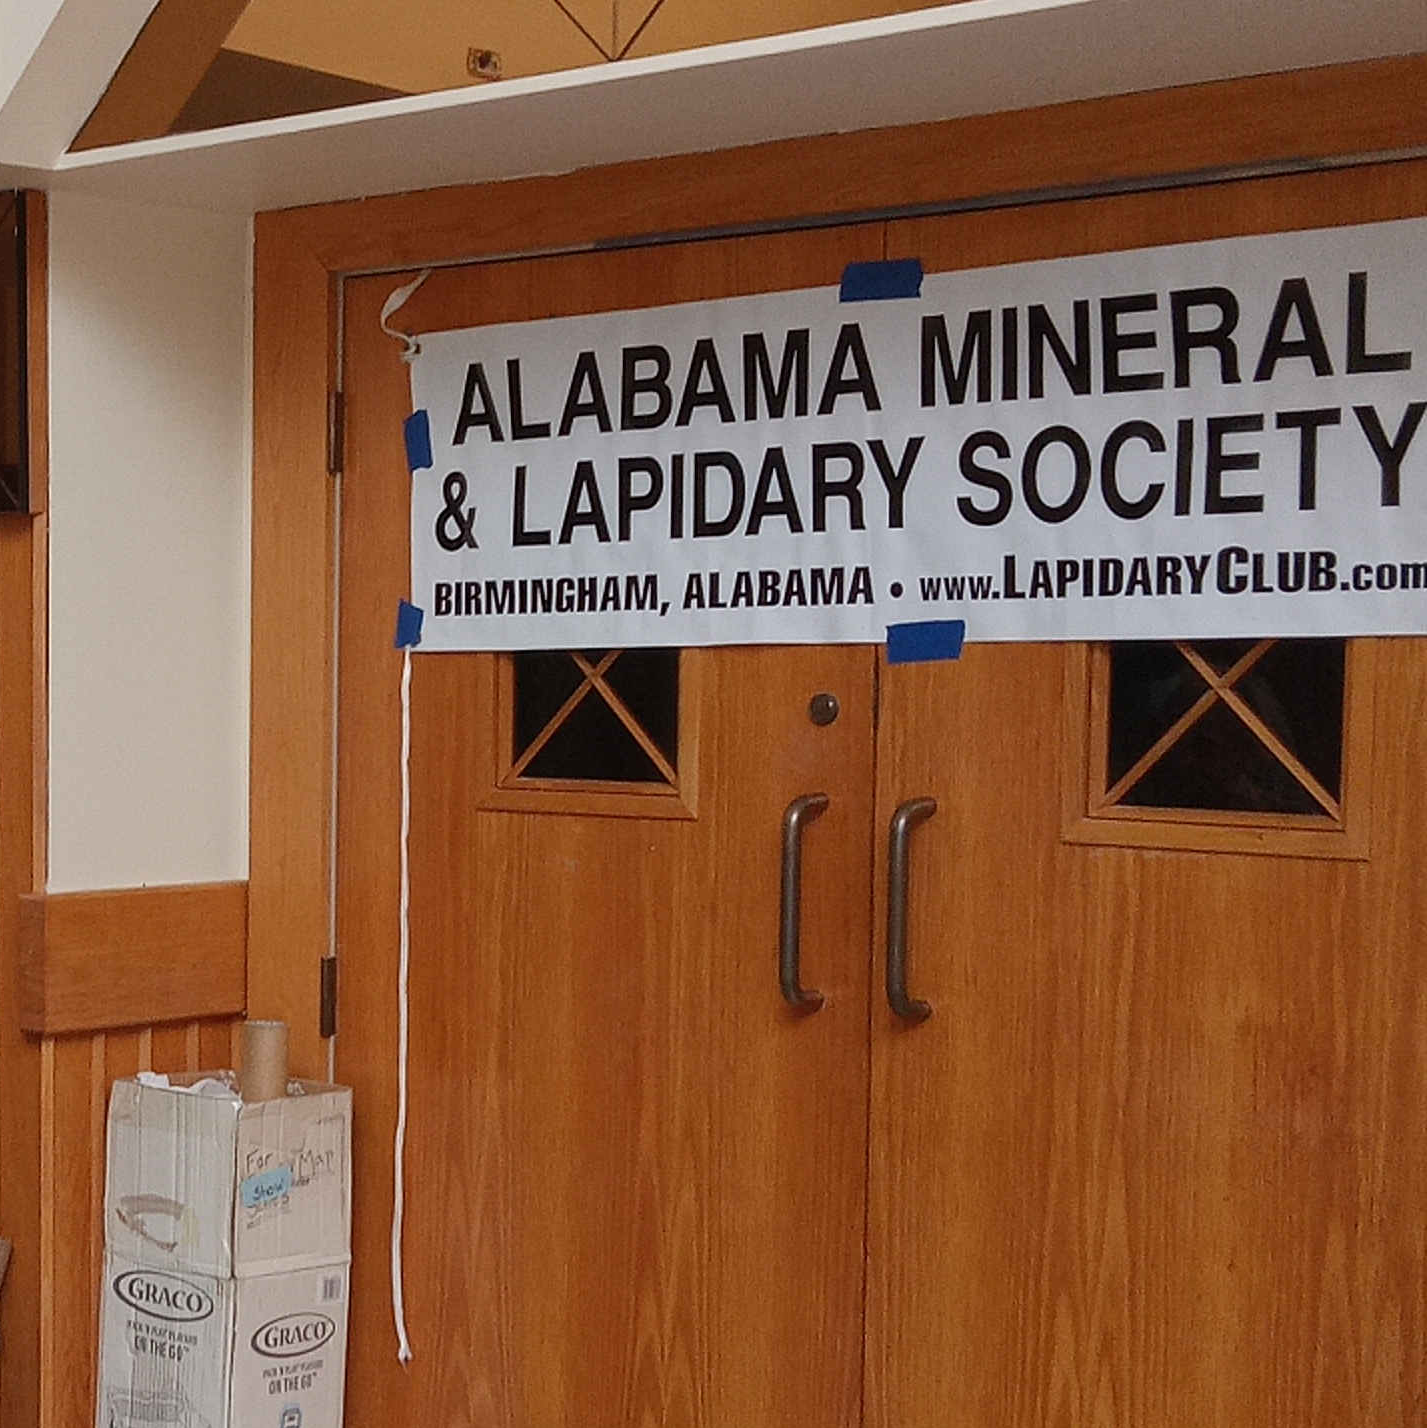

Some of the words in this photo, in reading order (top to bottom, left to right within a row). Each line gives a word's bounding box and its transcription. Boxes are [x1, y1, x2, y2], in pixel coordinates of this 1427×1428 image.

[452, 322, 882, 446] ALABAMA
[920, 271, 1412, 408] MINERAL
[435, 471, 479, 552] &
[512, 436, 925, 548] LAPIDARY
[956, 401, 1427, 527] SOCIETY
[434, 573, 671, 617] BIRMINGHAM,
[683, 565, 875, 610] ALABAMA
[128, 1277, 203, 1313] GRACO
[264, 1321, 326, 1349] GRACO
